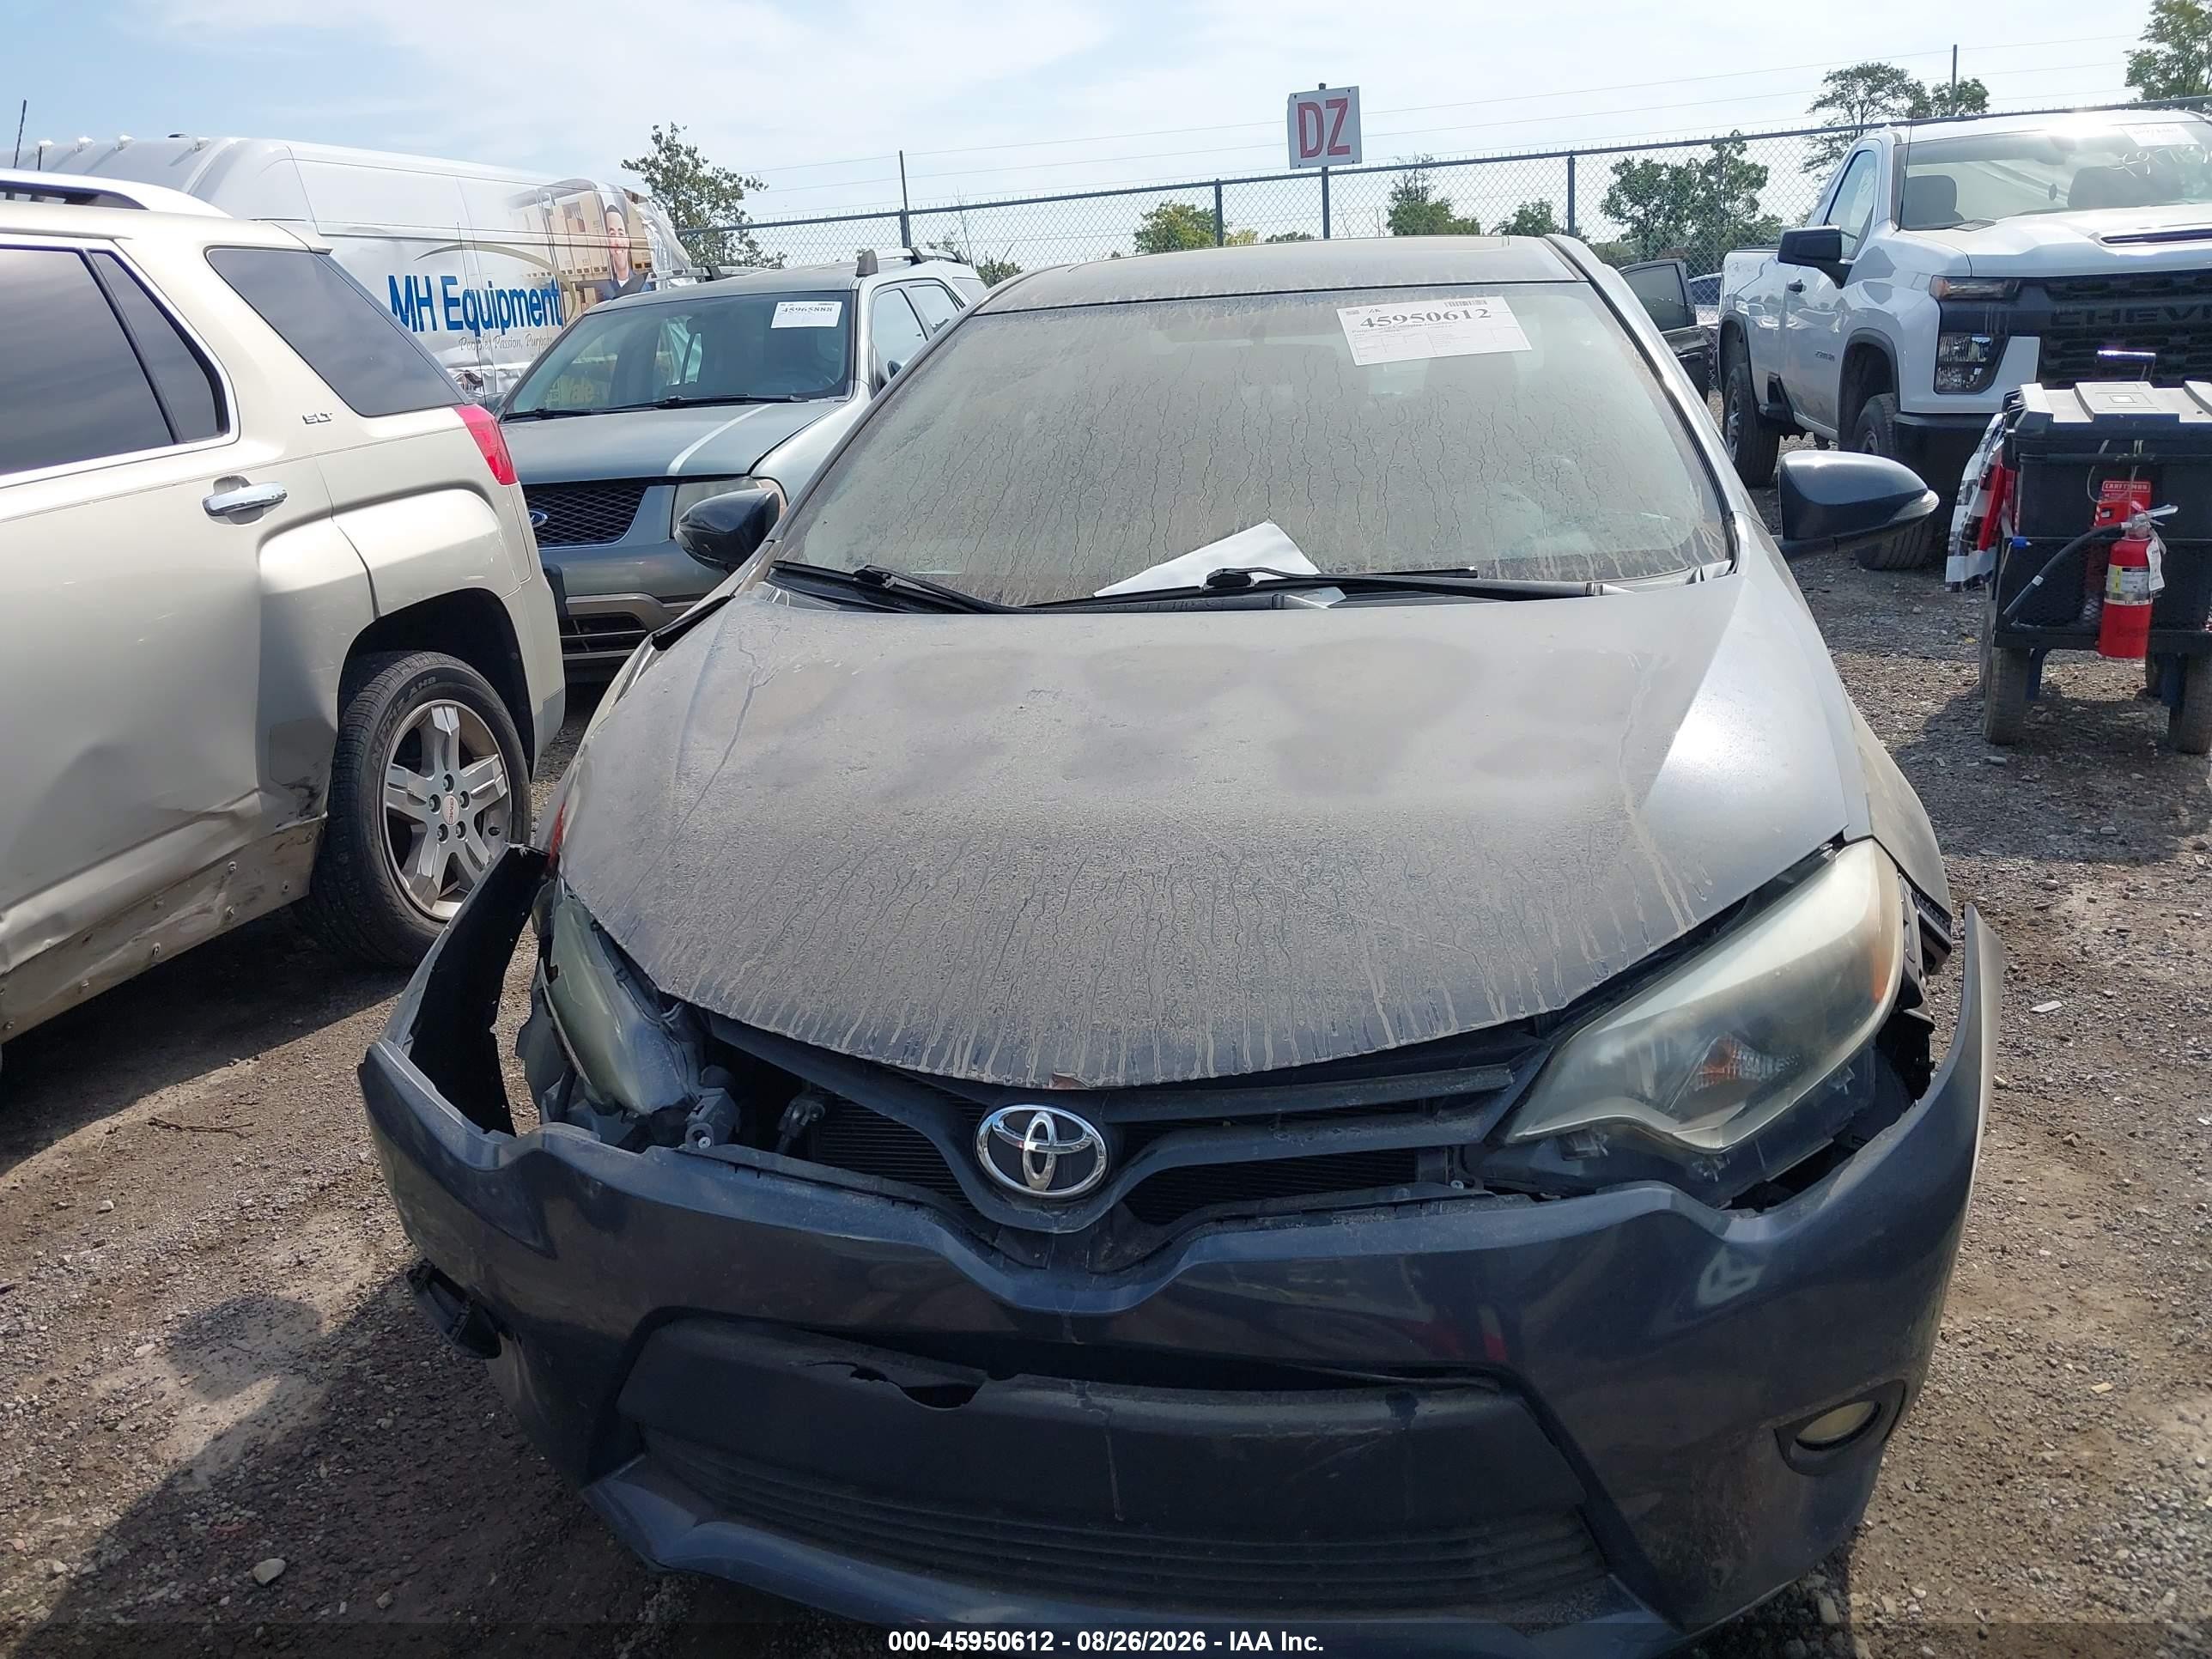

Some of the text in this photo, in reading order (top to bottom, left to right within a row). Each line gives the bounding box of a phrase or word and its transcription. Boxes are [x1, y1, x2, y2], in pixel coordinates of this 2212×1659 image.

[1297, 98, 1351, 159] DZ
[388, 275, 565, 337] MH Equipment
[1359, 308, 1492, 328] 45950612
[302, 412, 333, 425] SLT
